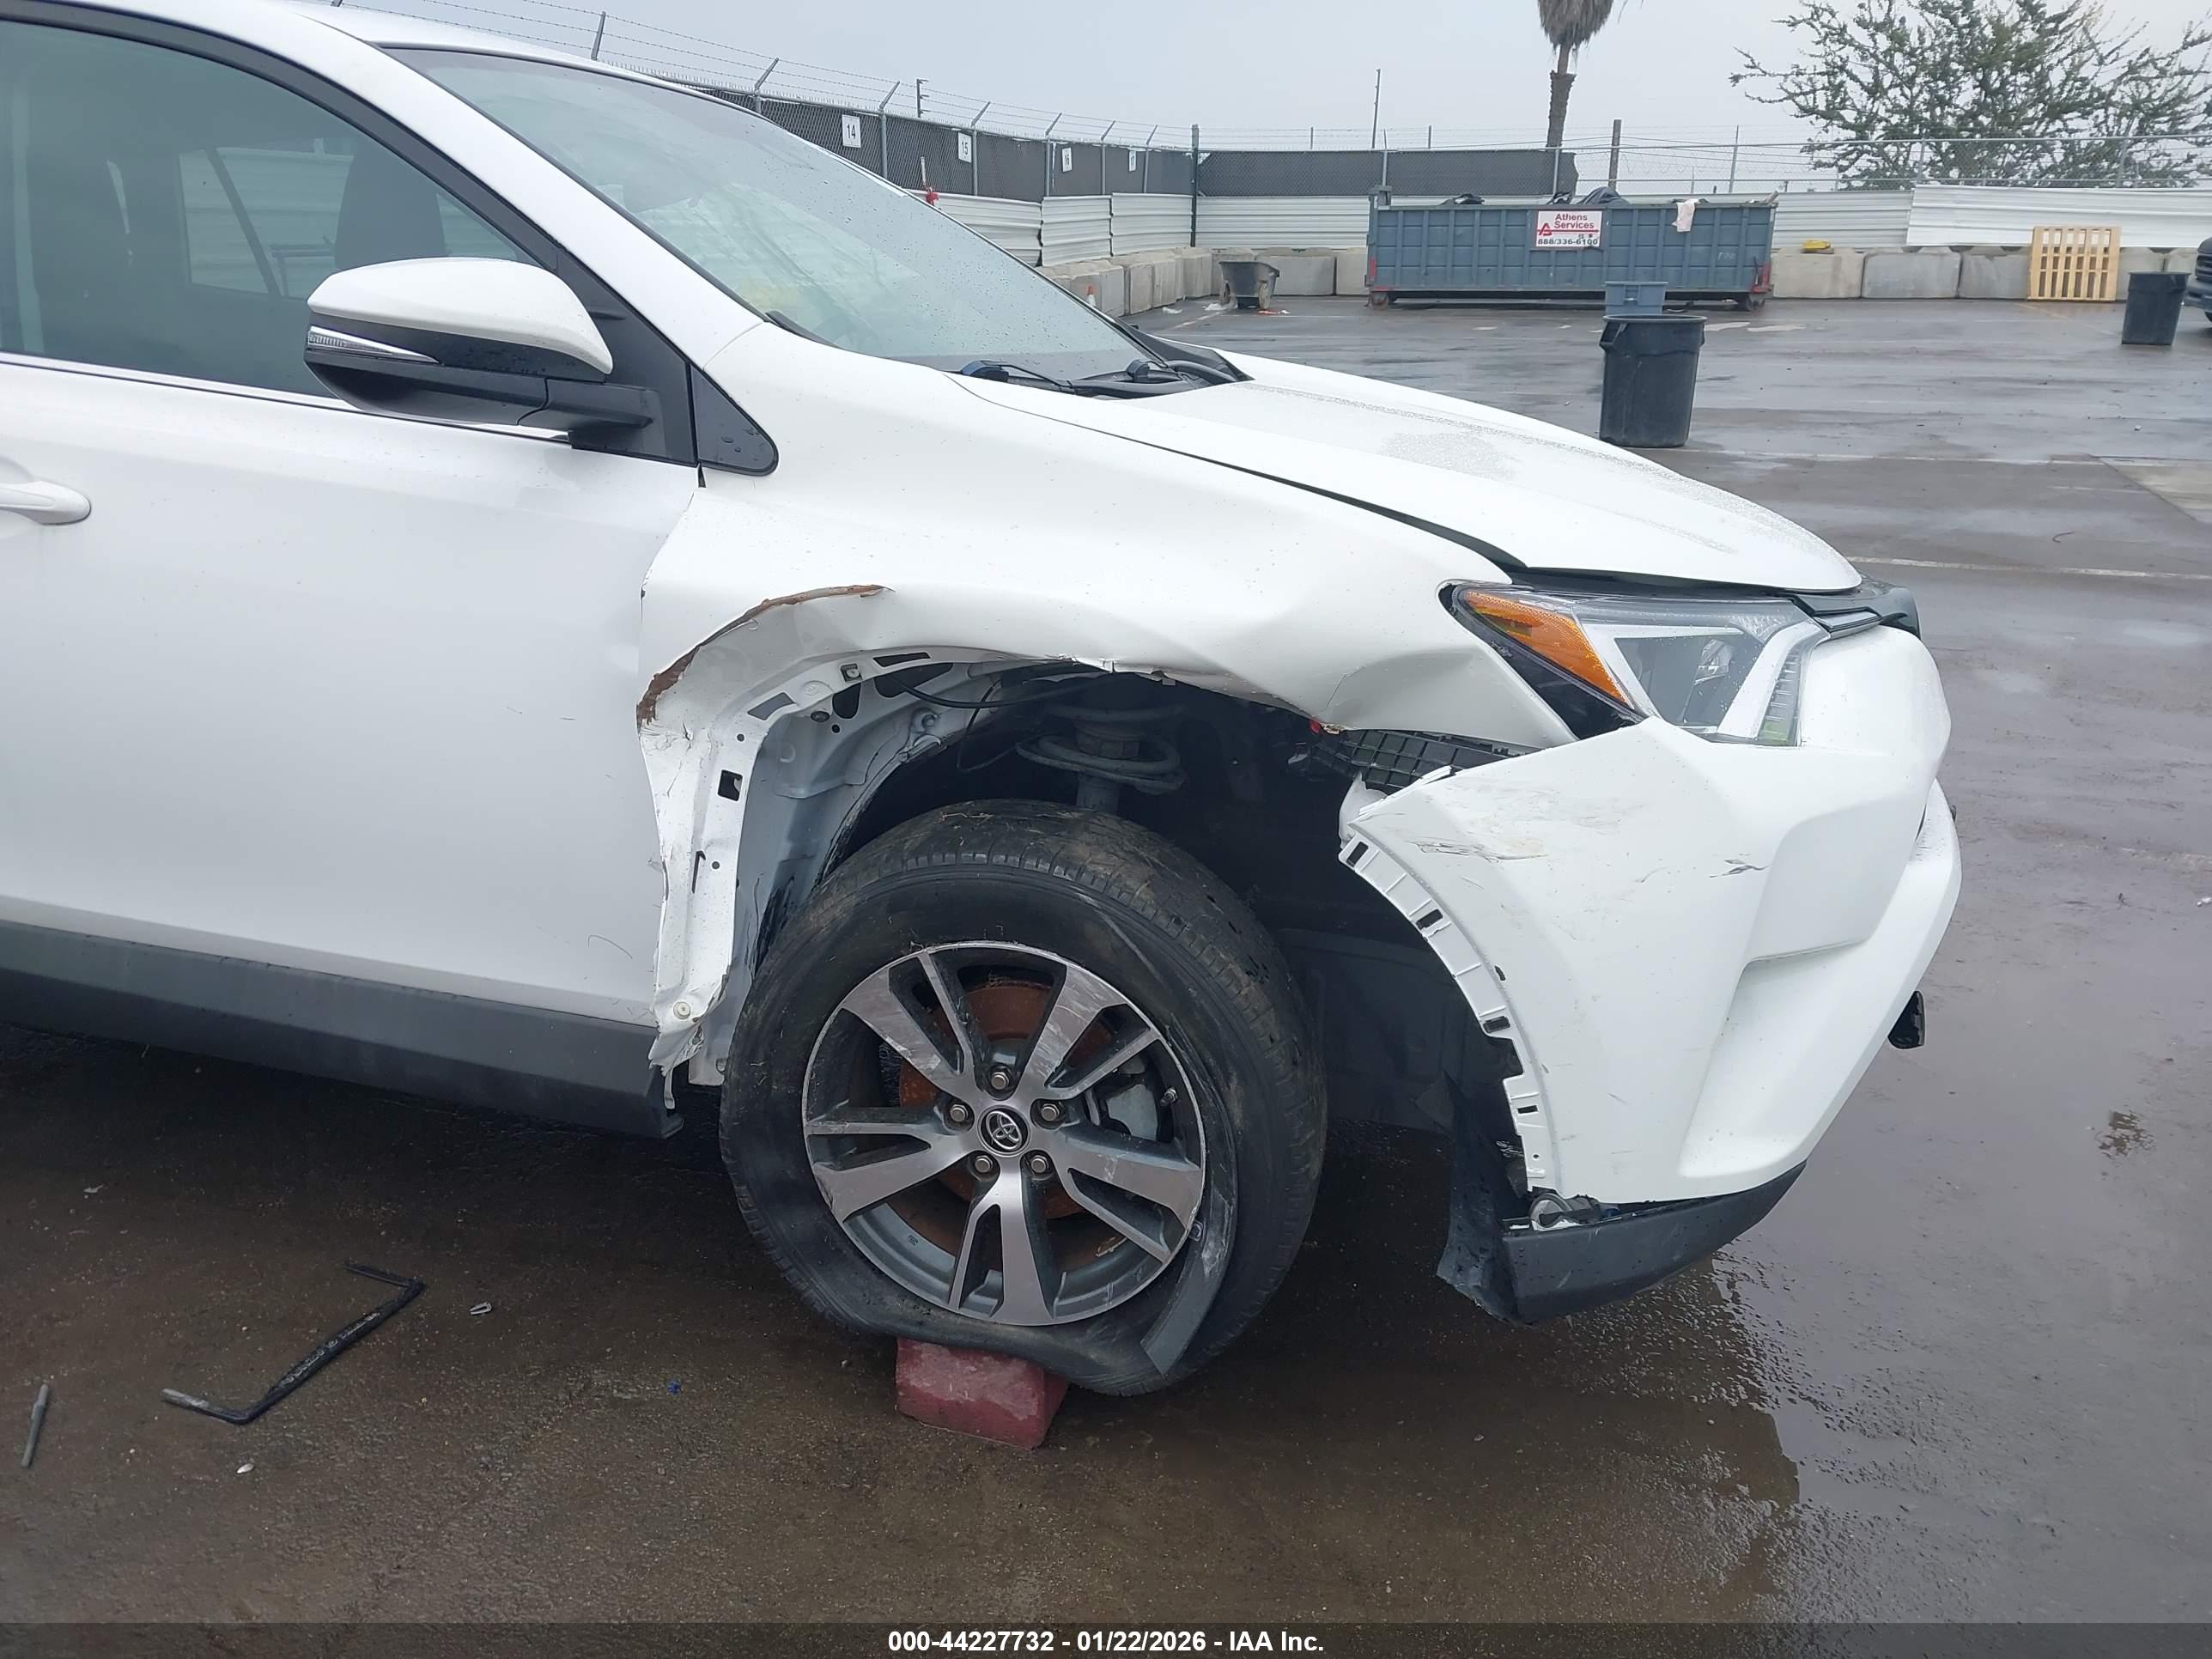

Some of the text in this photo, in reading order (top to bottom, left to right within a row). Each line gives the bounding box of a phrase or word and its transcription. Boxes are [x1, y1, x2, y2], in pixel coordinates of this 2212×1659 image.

[847, 123, 856, 139] 14
[962, 140, 969, 155] 15
[1553, 221, 1595, 229] Services
